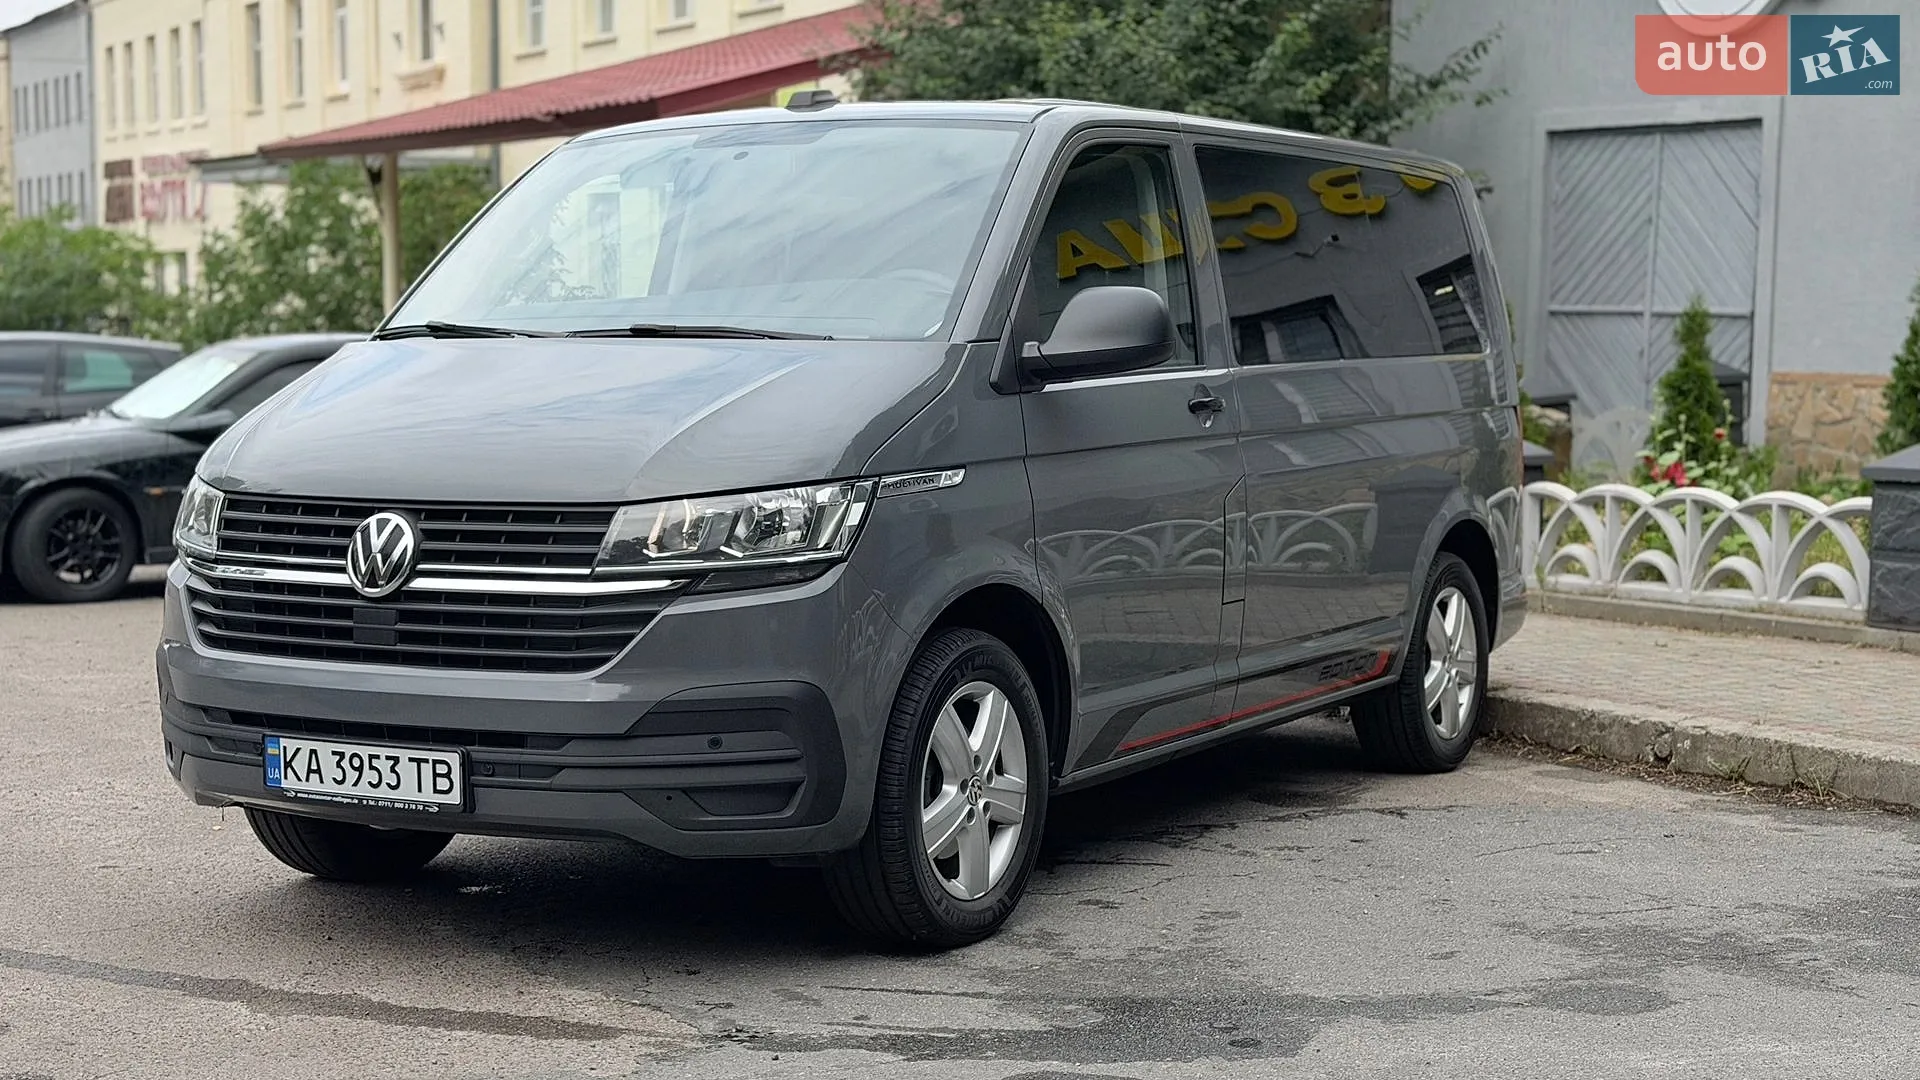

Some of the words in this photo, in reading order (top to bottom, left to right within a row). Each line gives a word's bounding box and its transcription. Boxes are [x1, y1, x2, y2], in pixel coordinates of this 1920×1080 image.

[268, 767, 280, 779] UA
[282, 745, 325, 784] KA
[331, 750, 401, 791] 3953
[408, 757, 454, 795] TB
